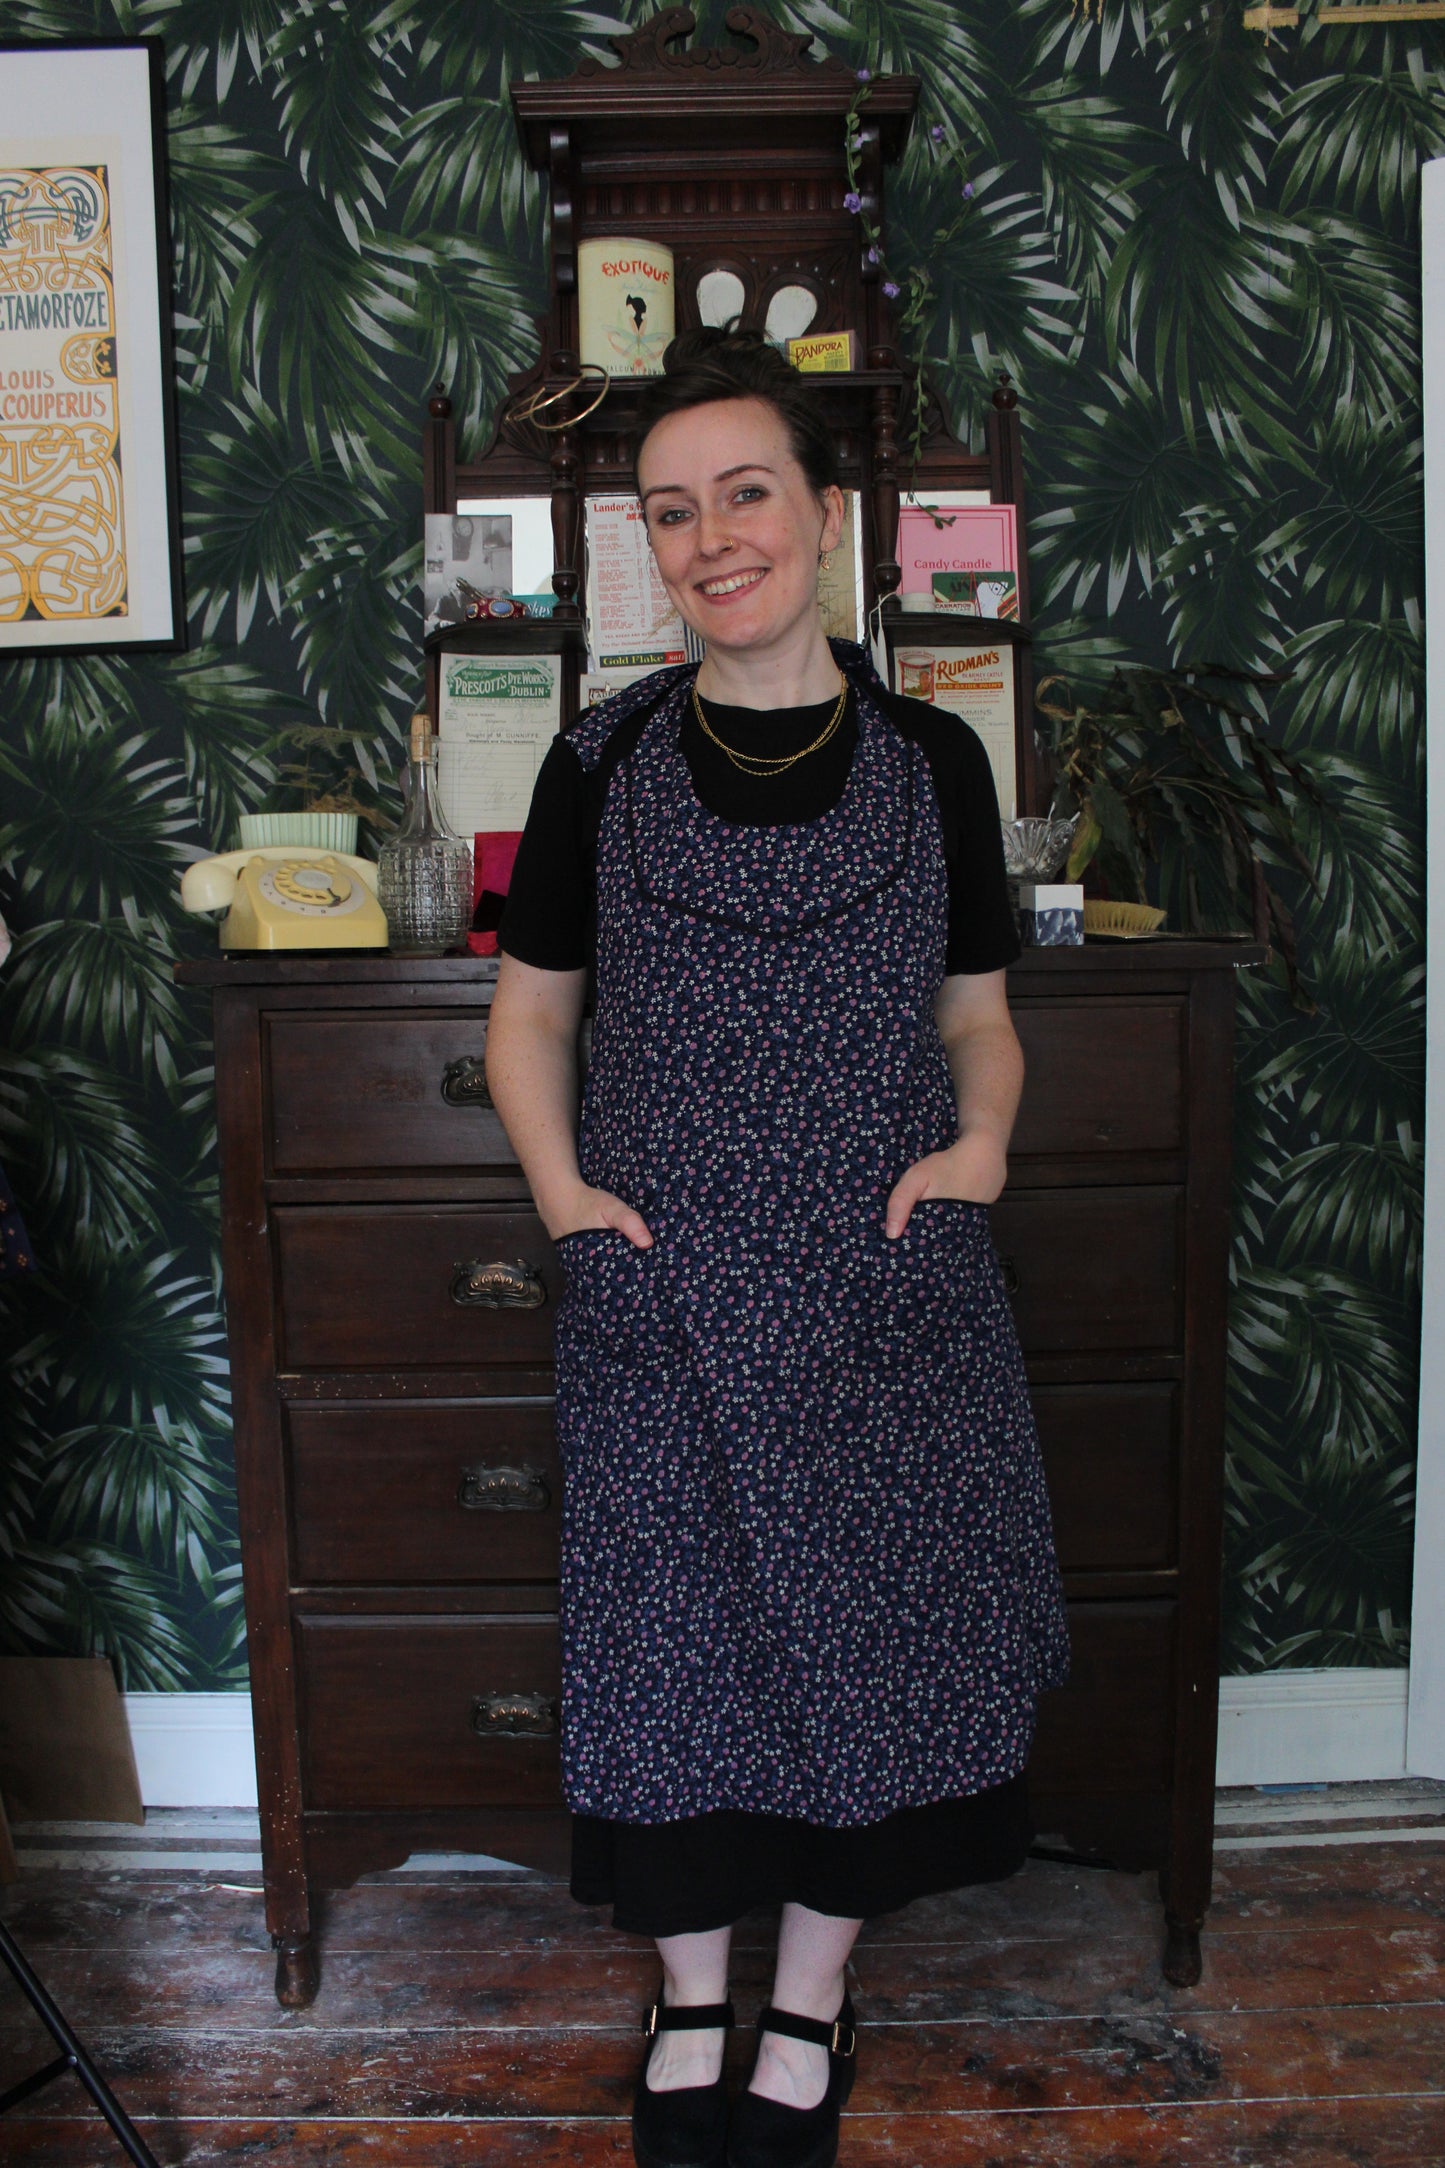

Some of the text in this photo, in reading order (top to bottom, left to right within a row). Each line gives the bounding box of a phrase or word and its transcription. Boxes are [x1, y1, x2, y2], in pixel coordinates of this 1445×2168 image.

[601, 260, 669, 285] EXOTIQUE
[795, 342, 842, 368] PANDORA
[3, 391, 106, 420] COUPERUS
[914, 559, 992, 571] Candy Candle
[603, 656, 629, 665] Gold
[631, 654, 664, 664] Flake
[936, 651, 1000, 684] RUDMAN'S
[454, 673, 507, 695] PRESCOTT'S
[510, 686, 544, 696] DUBLIN
